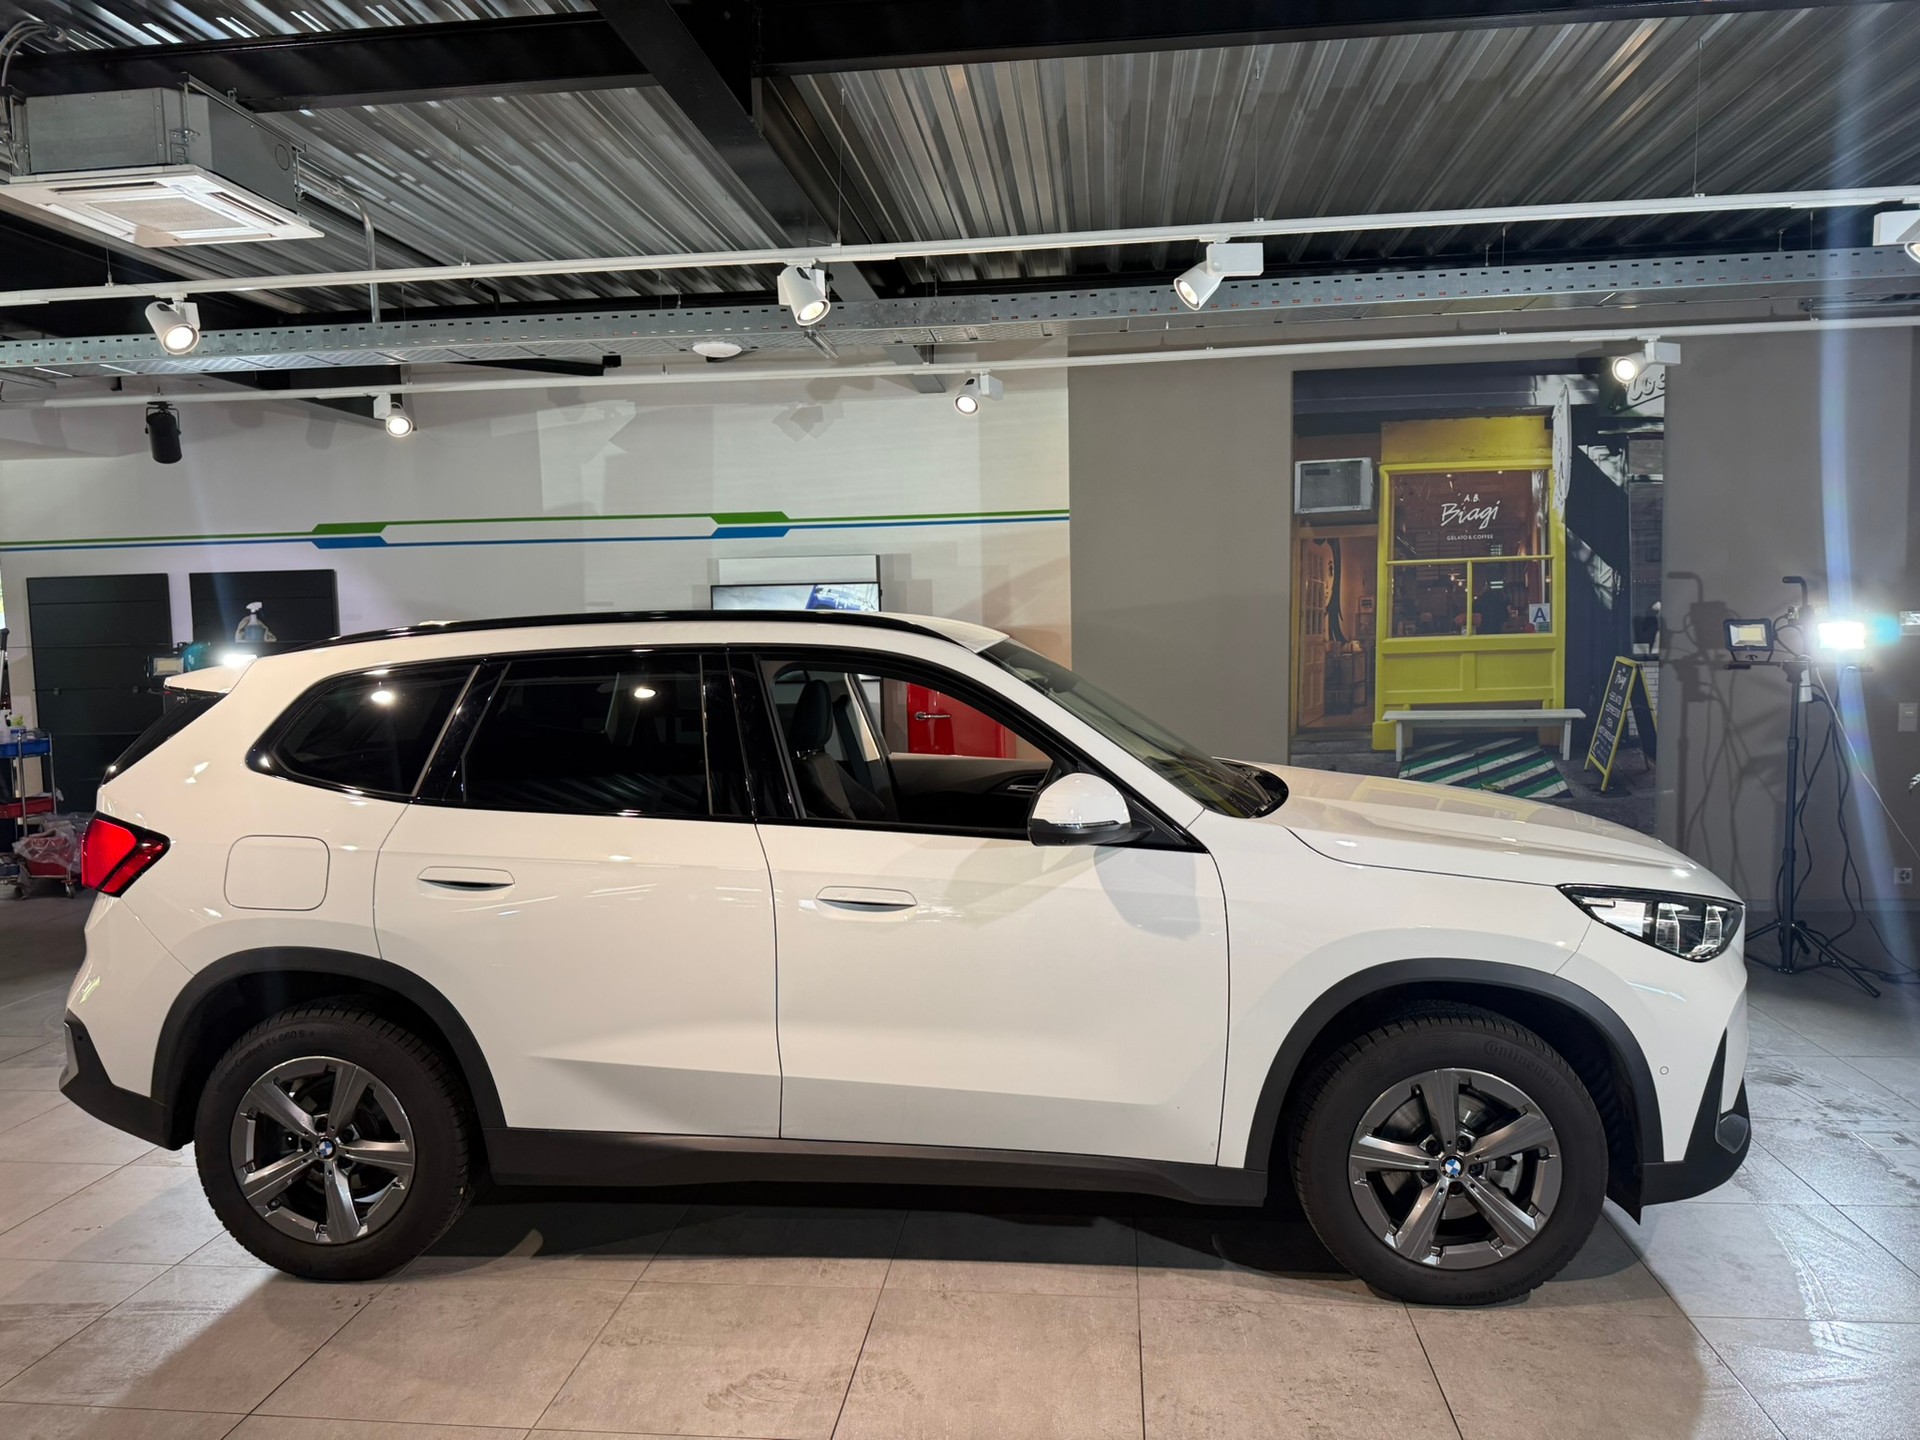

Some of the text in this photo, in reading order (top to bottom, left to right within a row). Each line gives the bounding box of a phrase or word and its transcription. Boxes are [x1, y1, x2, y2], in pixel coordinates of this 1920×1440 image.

[1440, 500, 1501, 530] Biagi
[1532, 606, 1547, 623] A
[1484, 1040, 1559, 1088] Continental
